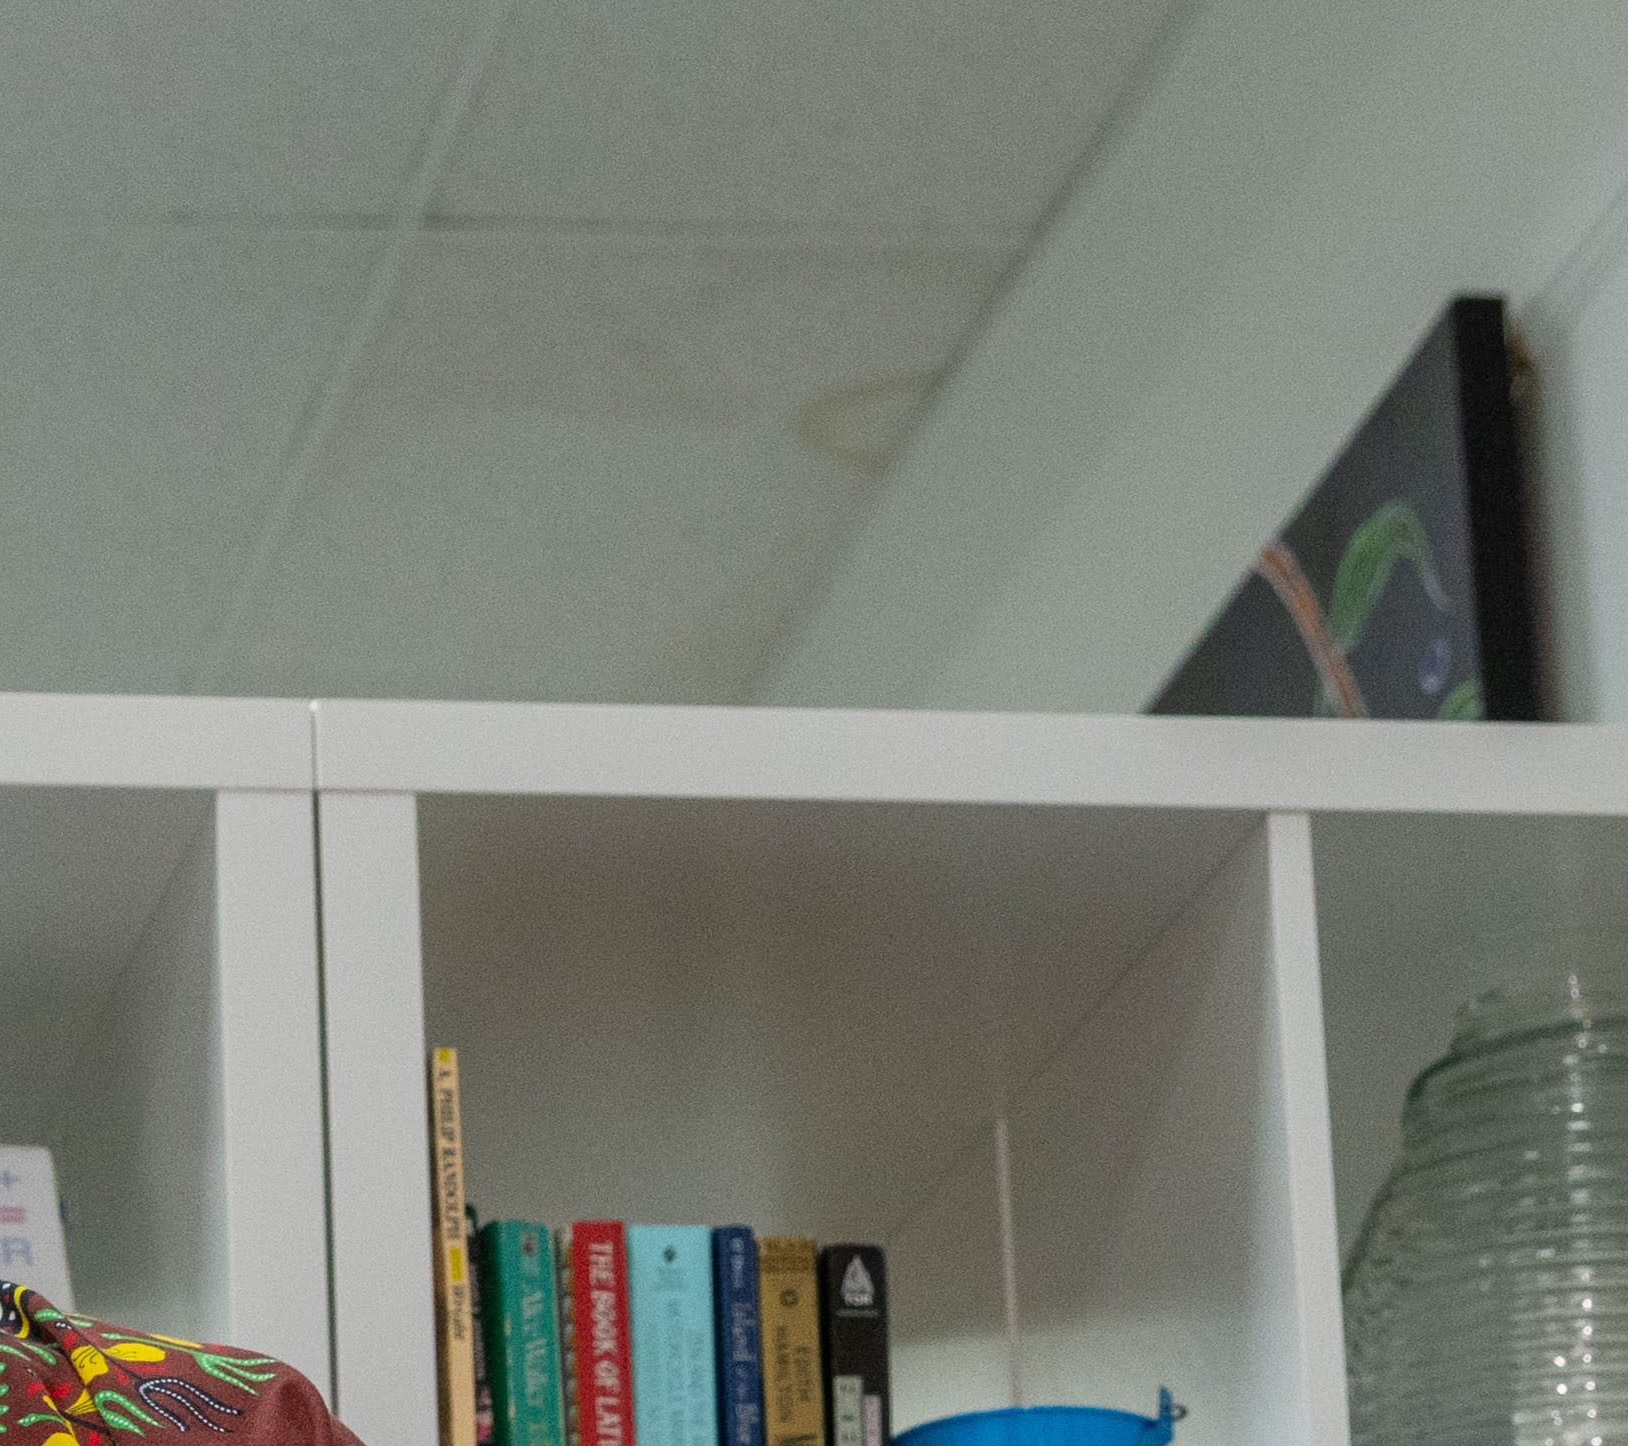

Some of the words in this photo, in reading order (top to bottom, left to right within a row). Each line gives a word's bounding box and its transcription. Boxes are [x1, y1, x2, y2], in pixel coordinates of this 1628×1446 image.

[437, 1069, 452, 1082] A.
[440, 1088, 457, 1142] PHILIP
[443, 1148, 462, 1240] RANDOLPH
[588, 1242, 613, 1285] THE
[450, 1284, 467, 1342] Wright
[591, 1291, 616, 1354] BOOK
[731, 1303, 755, 1361] Island
[592, 1360, 617, 1391] OF
[774, 1326, 793, 1422] HAMILTON
[795, 1346, 811, 1402] EDITH
[736, 1403, 756, 1444] Blue
